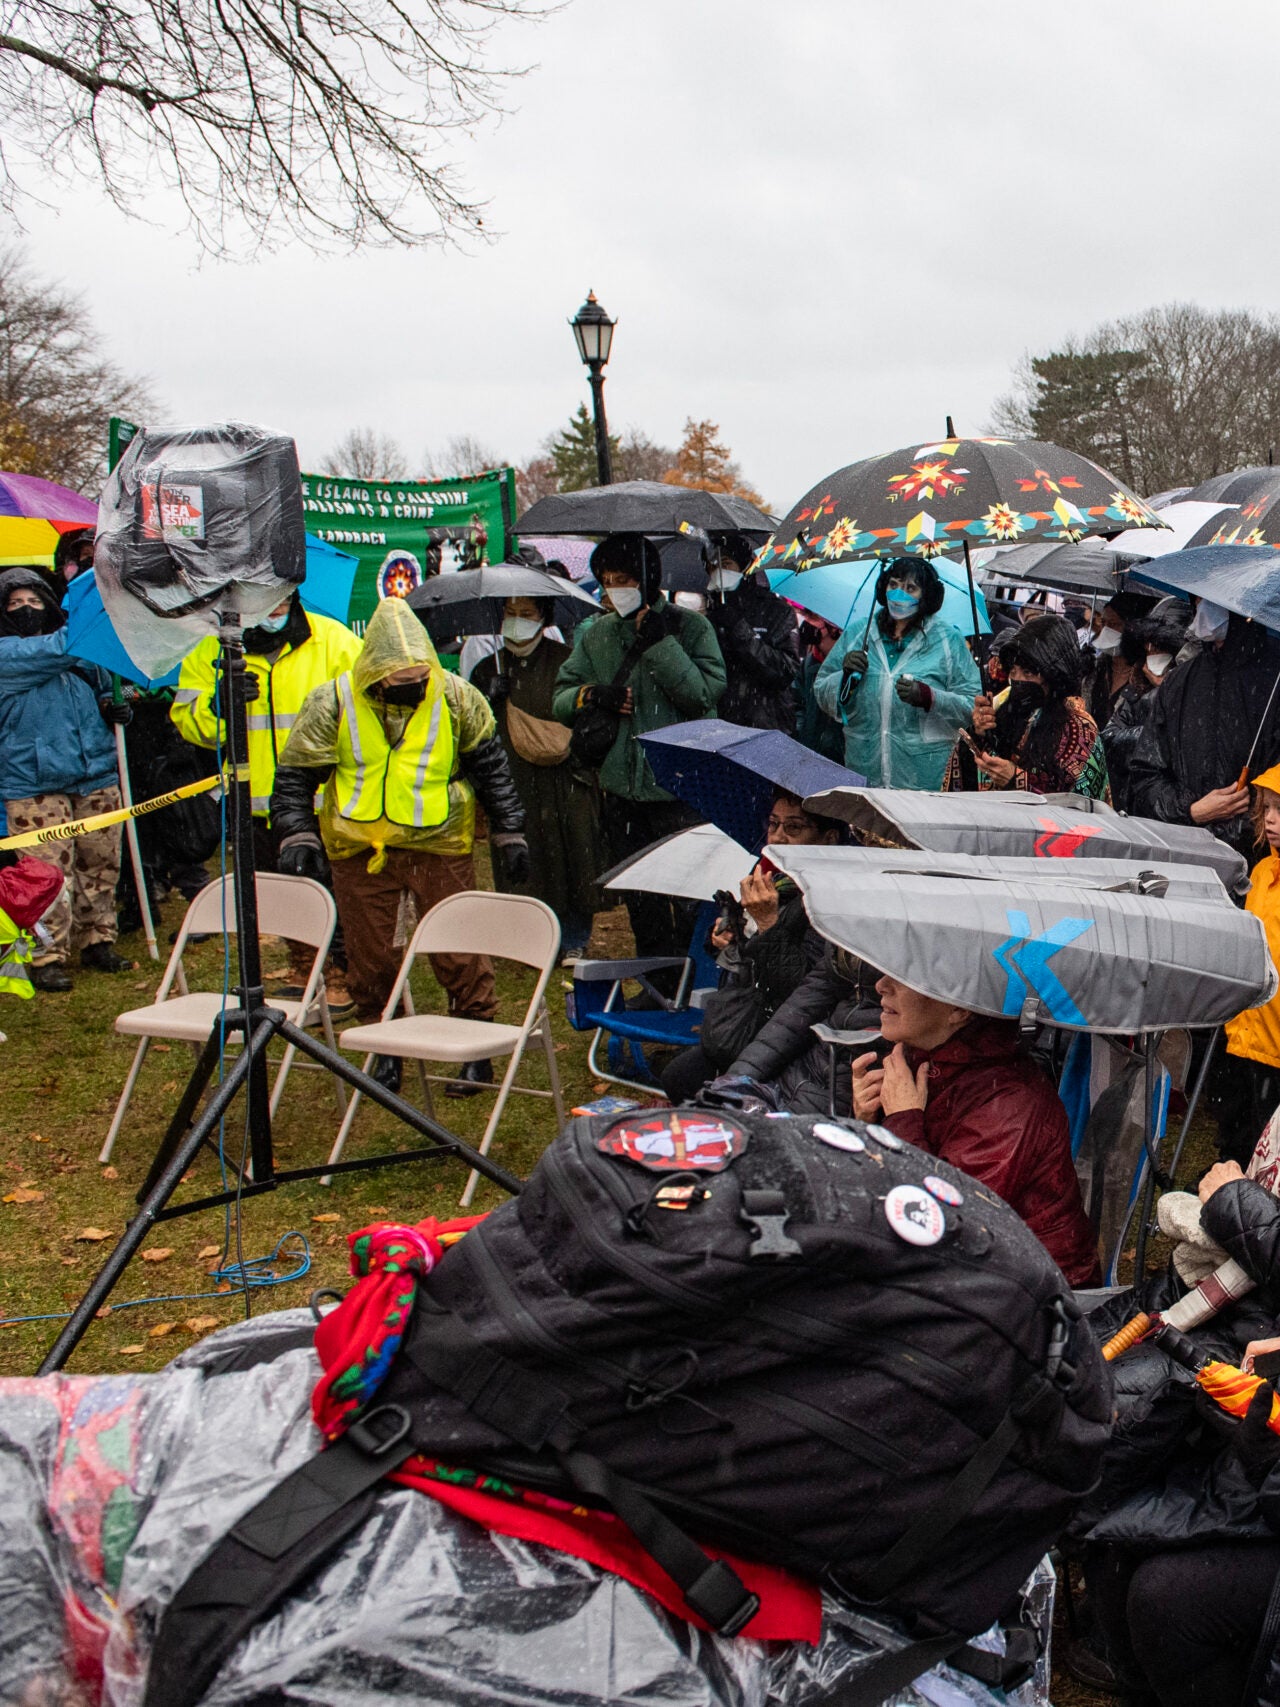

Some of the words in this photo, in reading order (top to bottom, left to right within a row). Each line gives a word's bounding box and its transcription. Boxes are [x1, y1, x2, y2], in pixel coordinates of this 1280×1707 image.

[317, 483, 370, 501] ISLAND
[376, 490, 393, 504] TO
[398, 492, 468, 505] PALESTINE
[161, 504, 190, 518] SEA
[358, 503, 375, 517] IS
[380, 505, 390, 519] A
[394, 505, 434, 519] CRIME
[318, 530, 387, 545] LANDBACK
